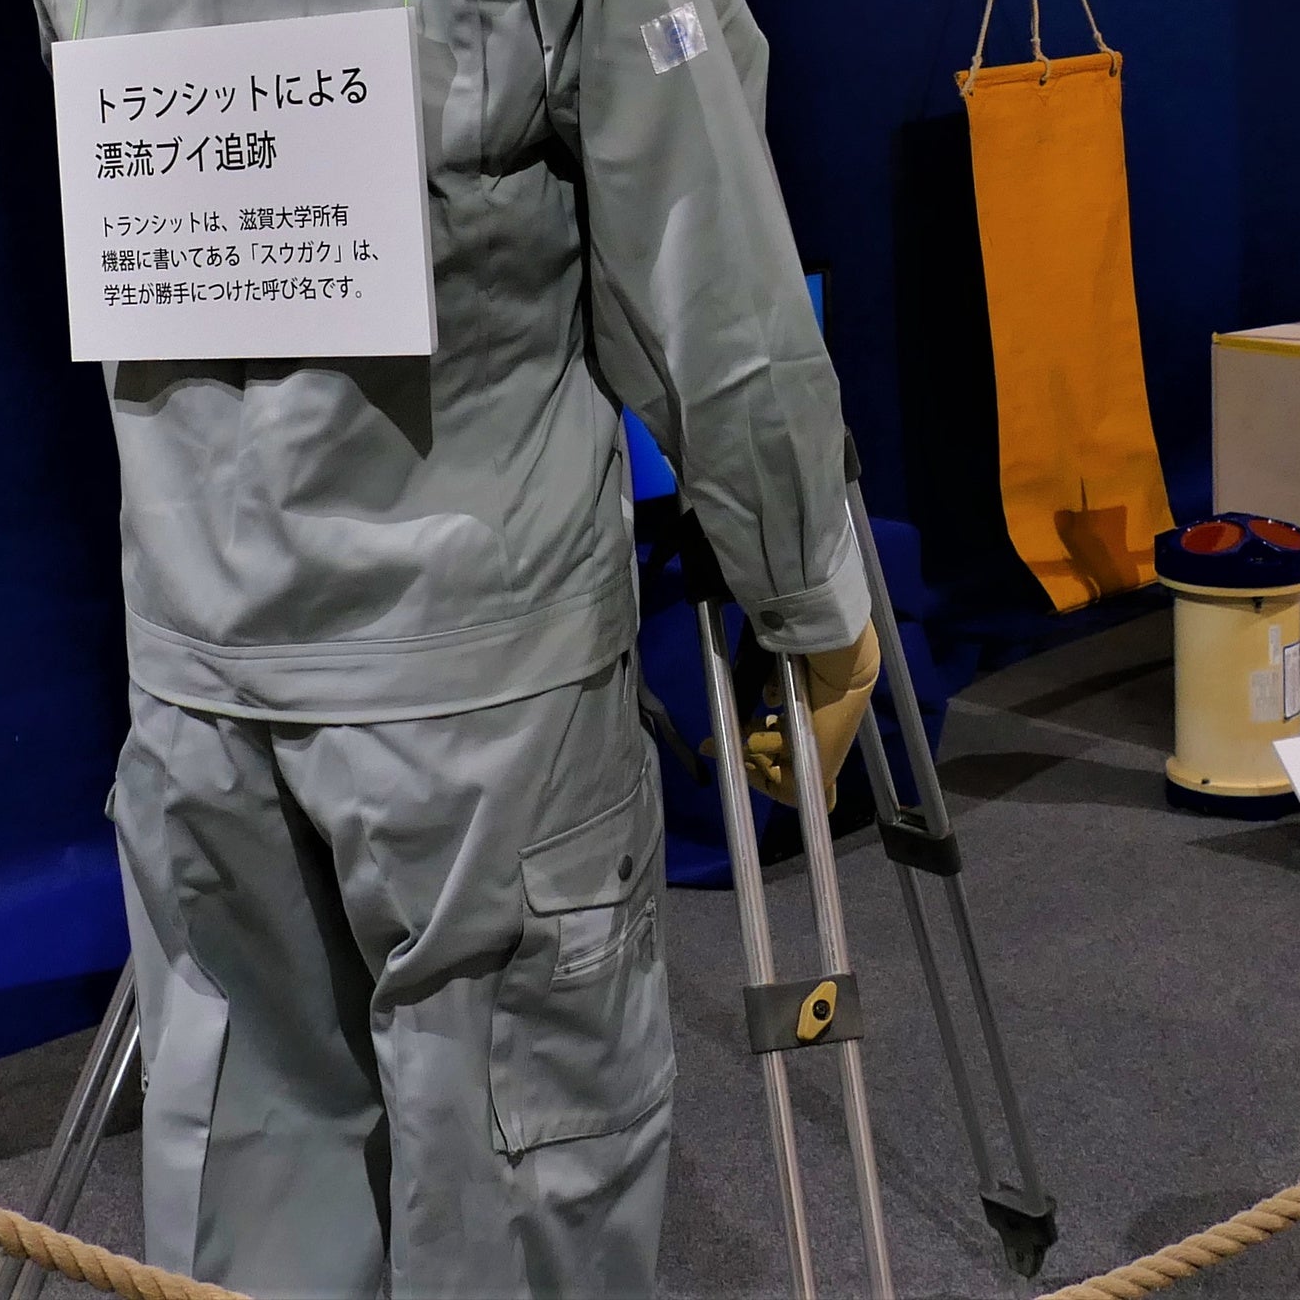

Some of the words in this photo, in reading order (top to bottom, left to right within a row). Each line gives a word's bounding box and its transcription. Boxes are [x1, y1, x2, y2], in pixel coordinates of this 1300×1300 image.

[99, 67, 368, 124] トランシットによる
[95, 130, 277, 180] 漂流ブイ追跡
[101, 203, 350, 238] トランシットは、滋賀大学所有
[101, 239, 380, 273] 機器に書いてある「スウガク」は、
[103, 275, 364, 307] 学生が勝手につけた呼び名です。
